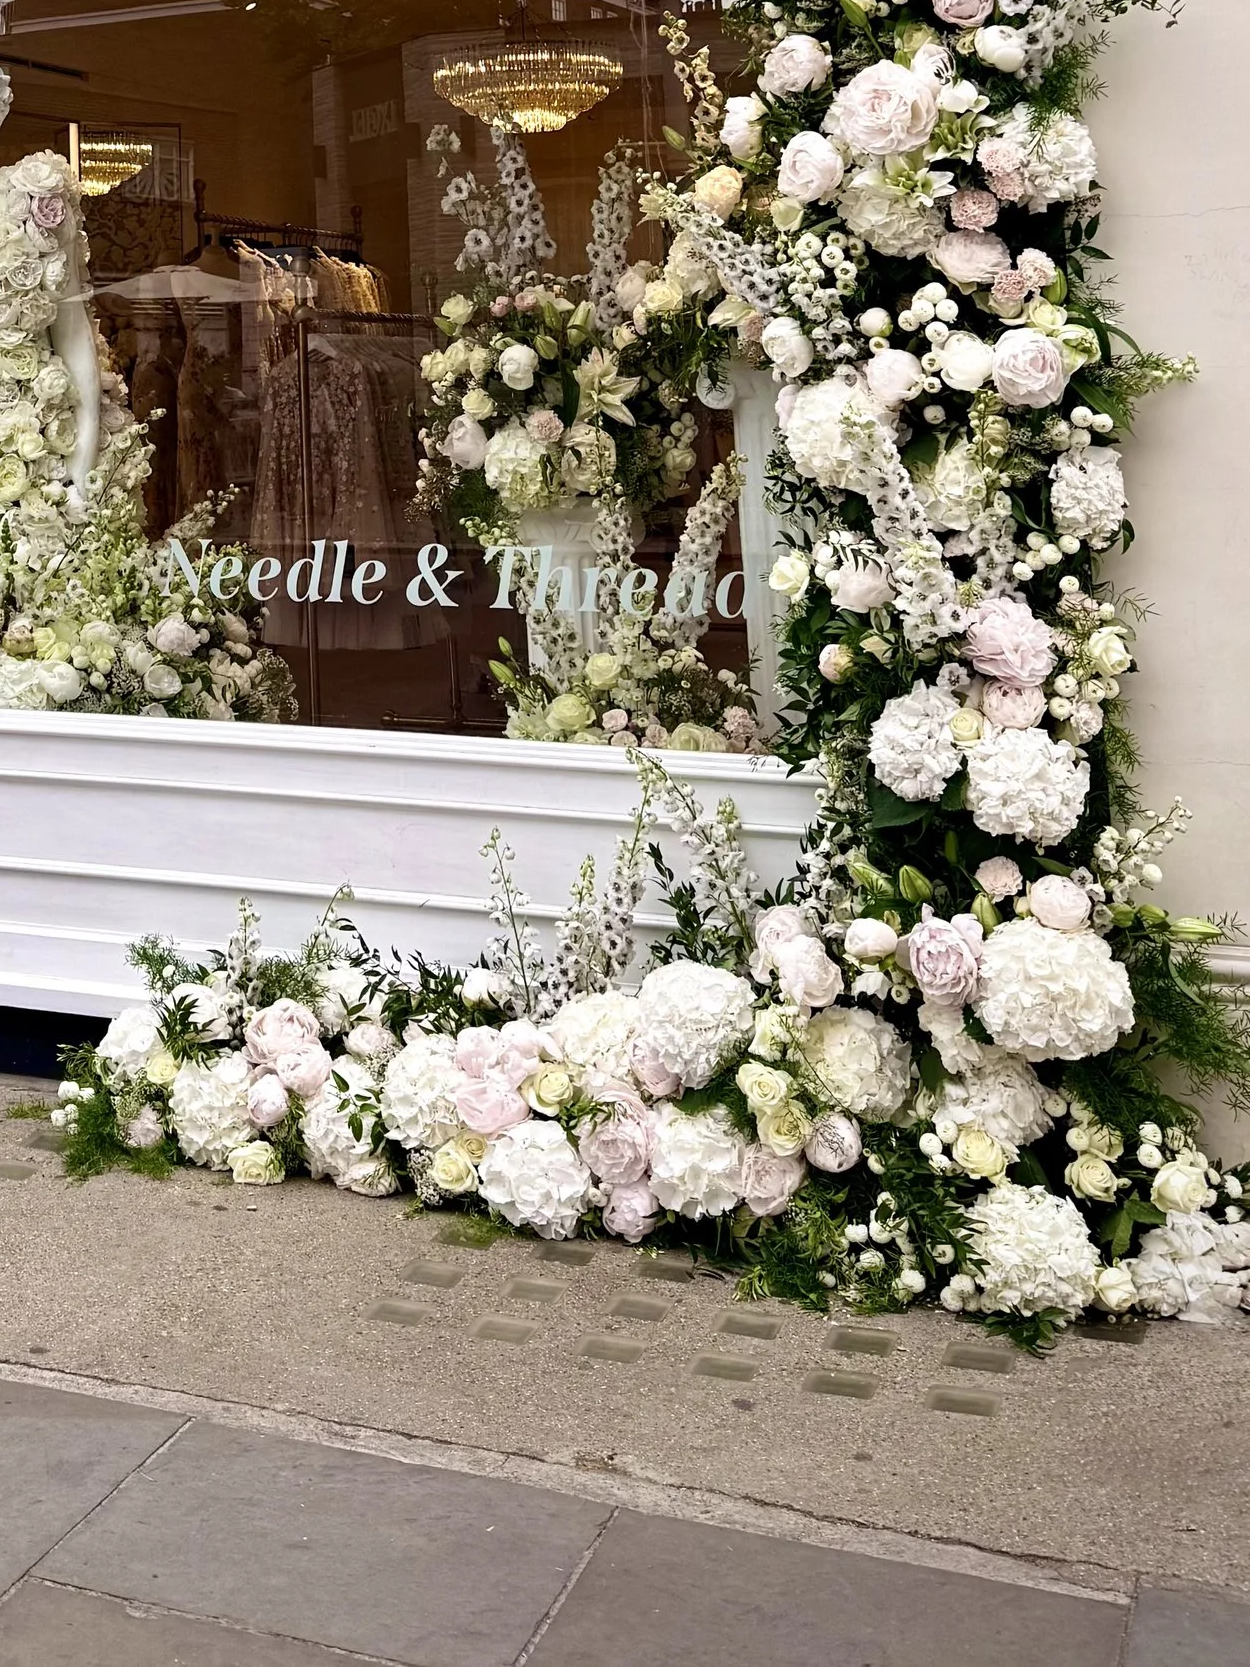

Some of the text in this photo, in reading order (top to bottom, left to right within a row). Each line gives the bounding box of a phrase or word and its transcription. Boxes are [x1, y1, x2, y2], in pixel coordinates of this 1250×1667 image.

[160, 538, 755, 620] Needle & Thread
